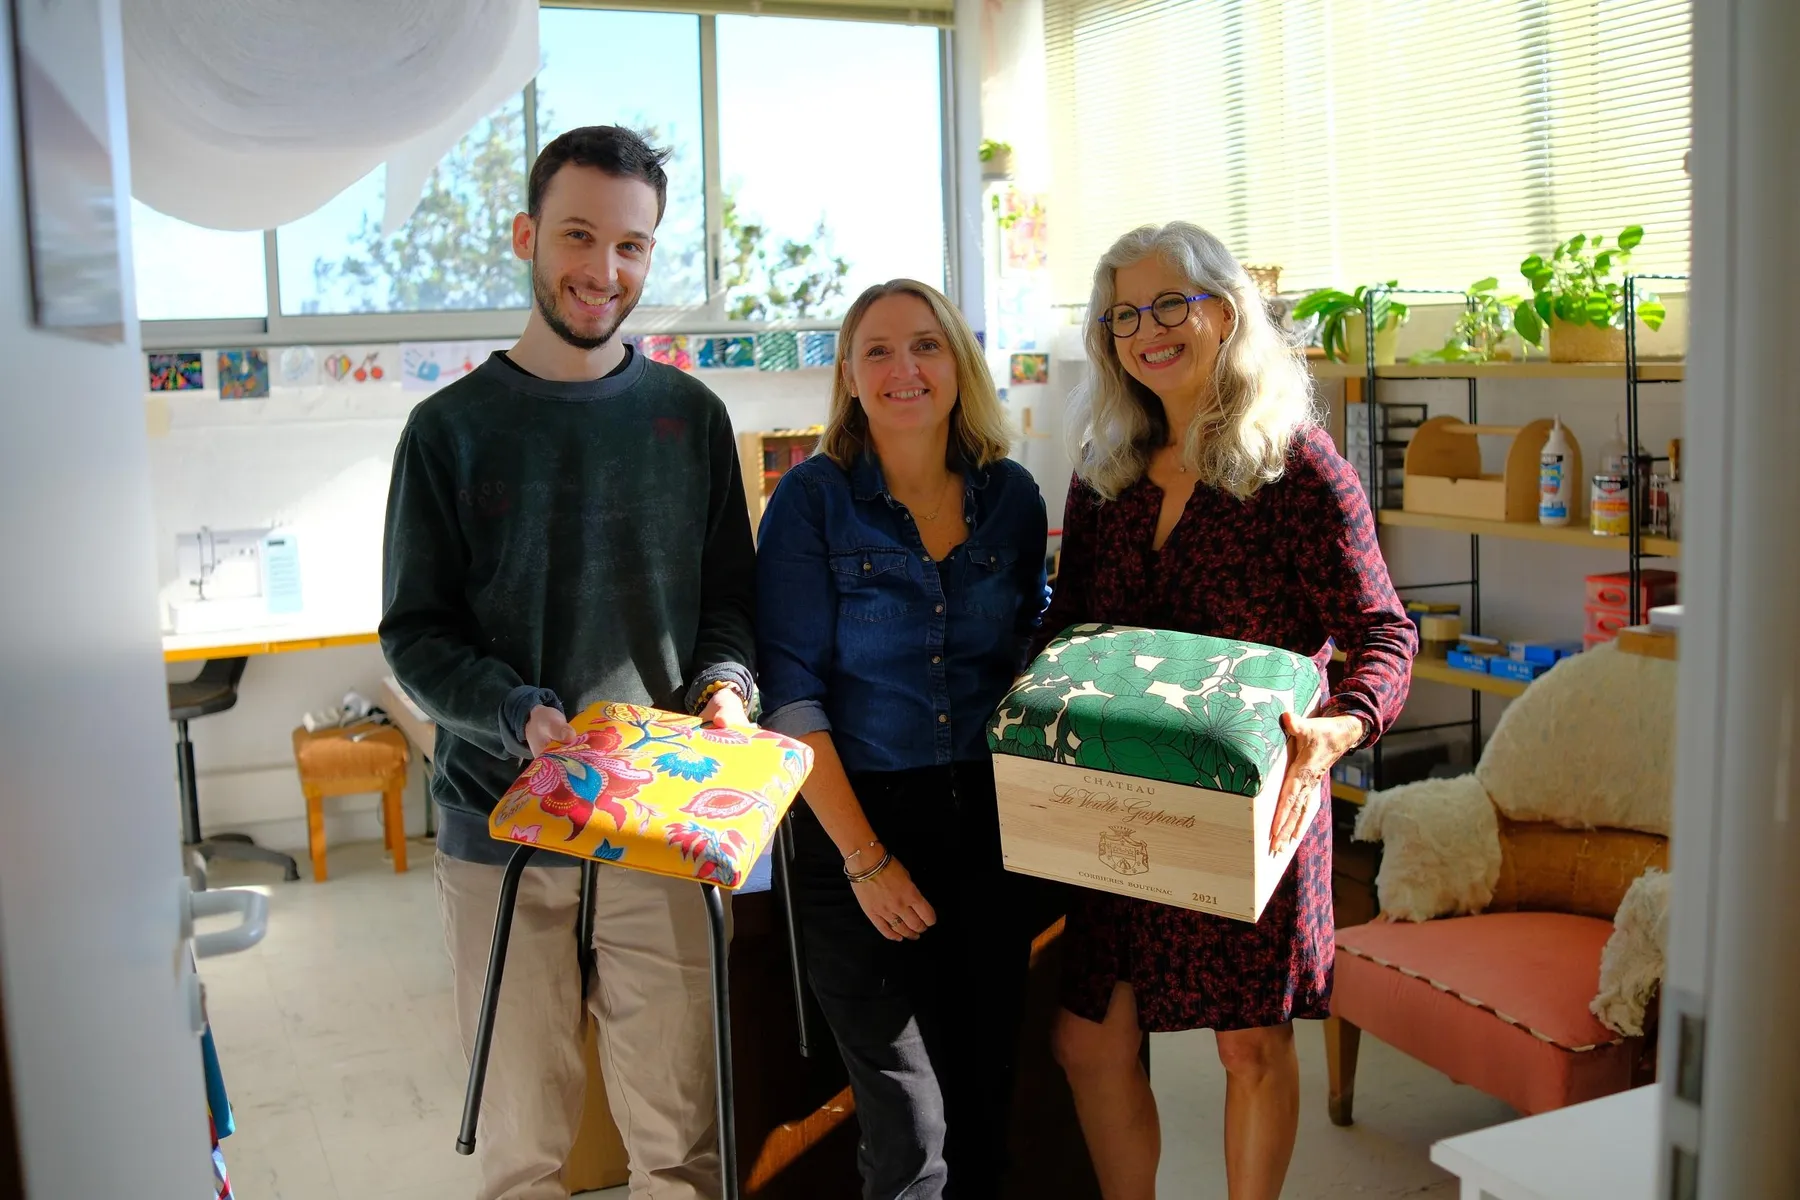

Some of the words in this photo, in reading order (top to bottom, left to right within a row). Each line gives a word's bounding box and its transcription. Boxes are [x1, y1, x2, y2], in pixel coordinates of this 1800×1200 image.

[1049, 784, 1077, 805] La
[1083, 775, 1156, 795] CHATEAU
[1078, 871, 1124, 885] CORBIERES
[1127, 881, 1173, 896] BOUTENAC
[1192, 892, 1218, 905] 2021
